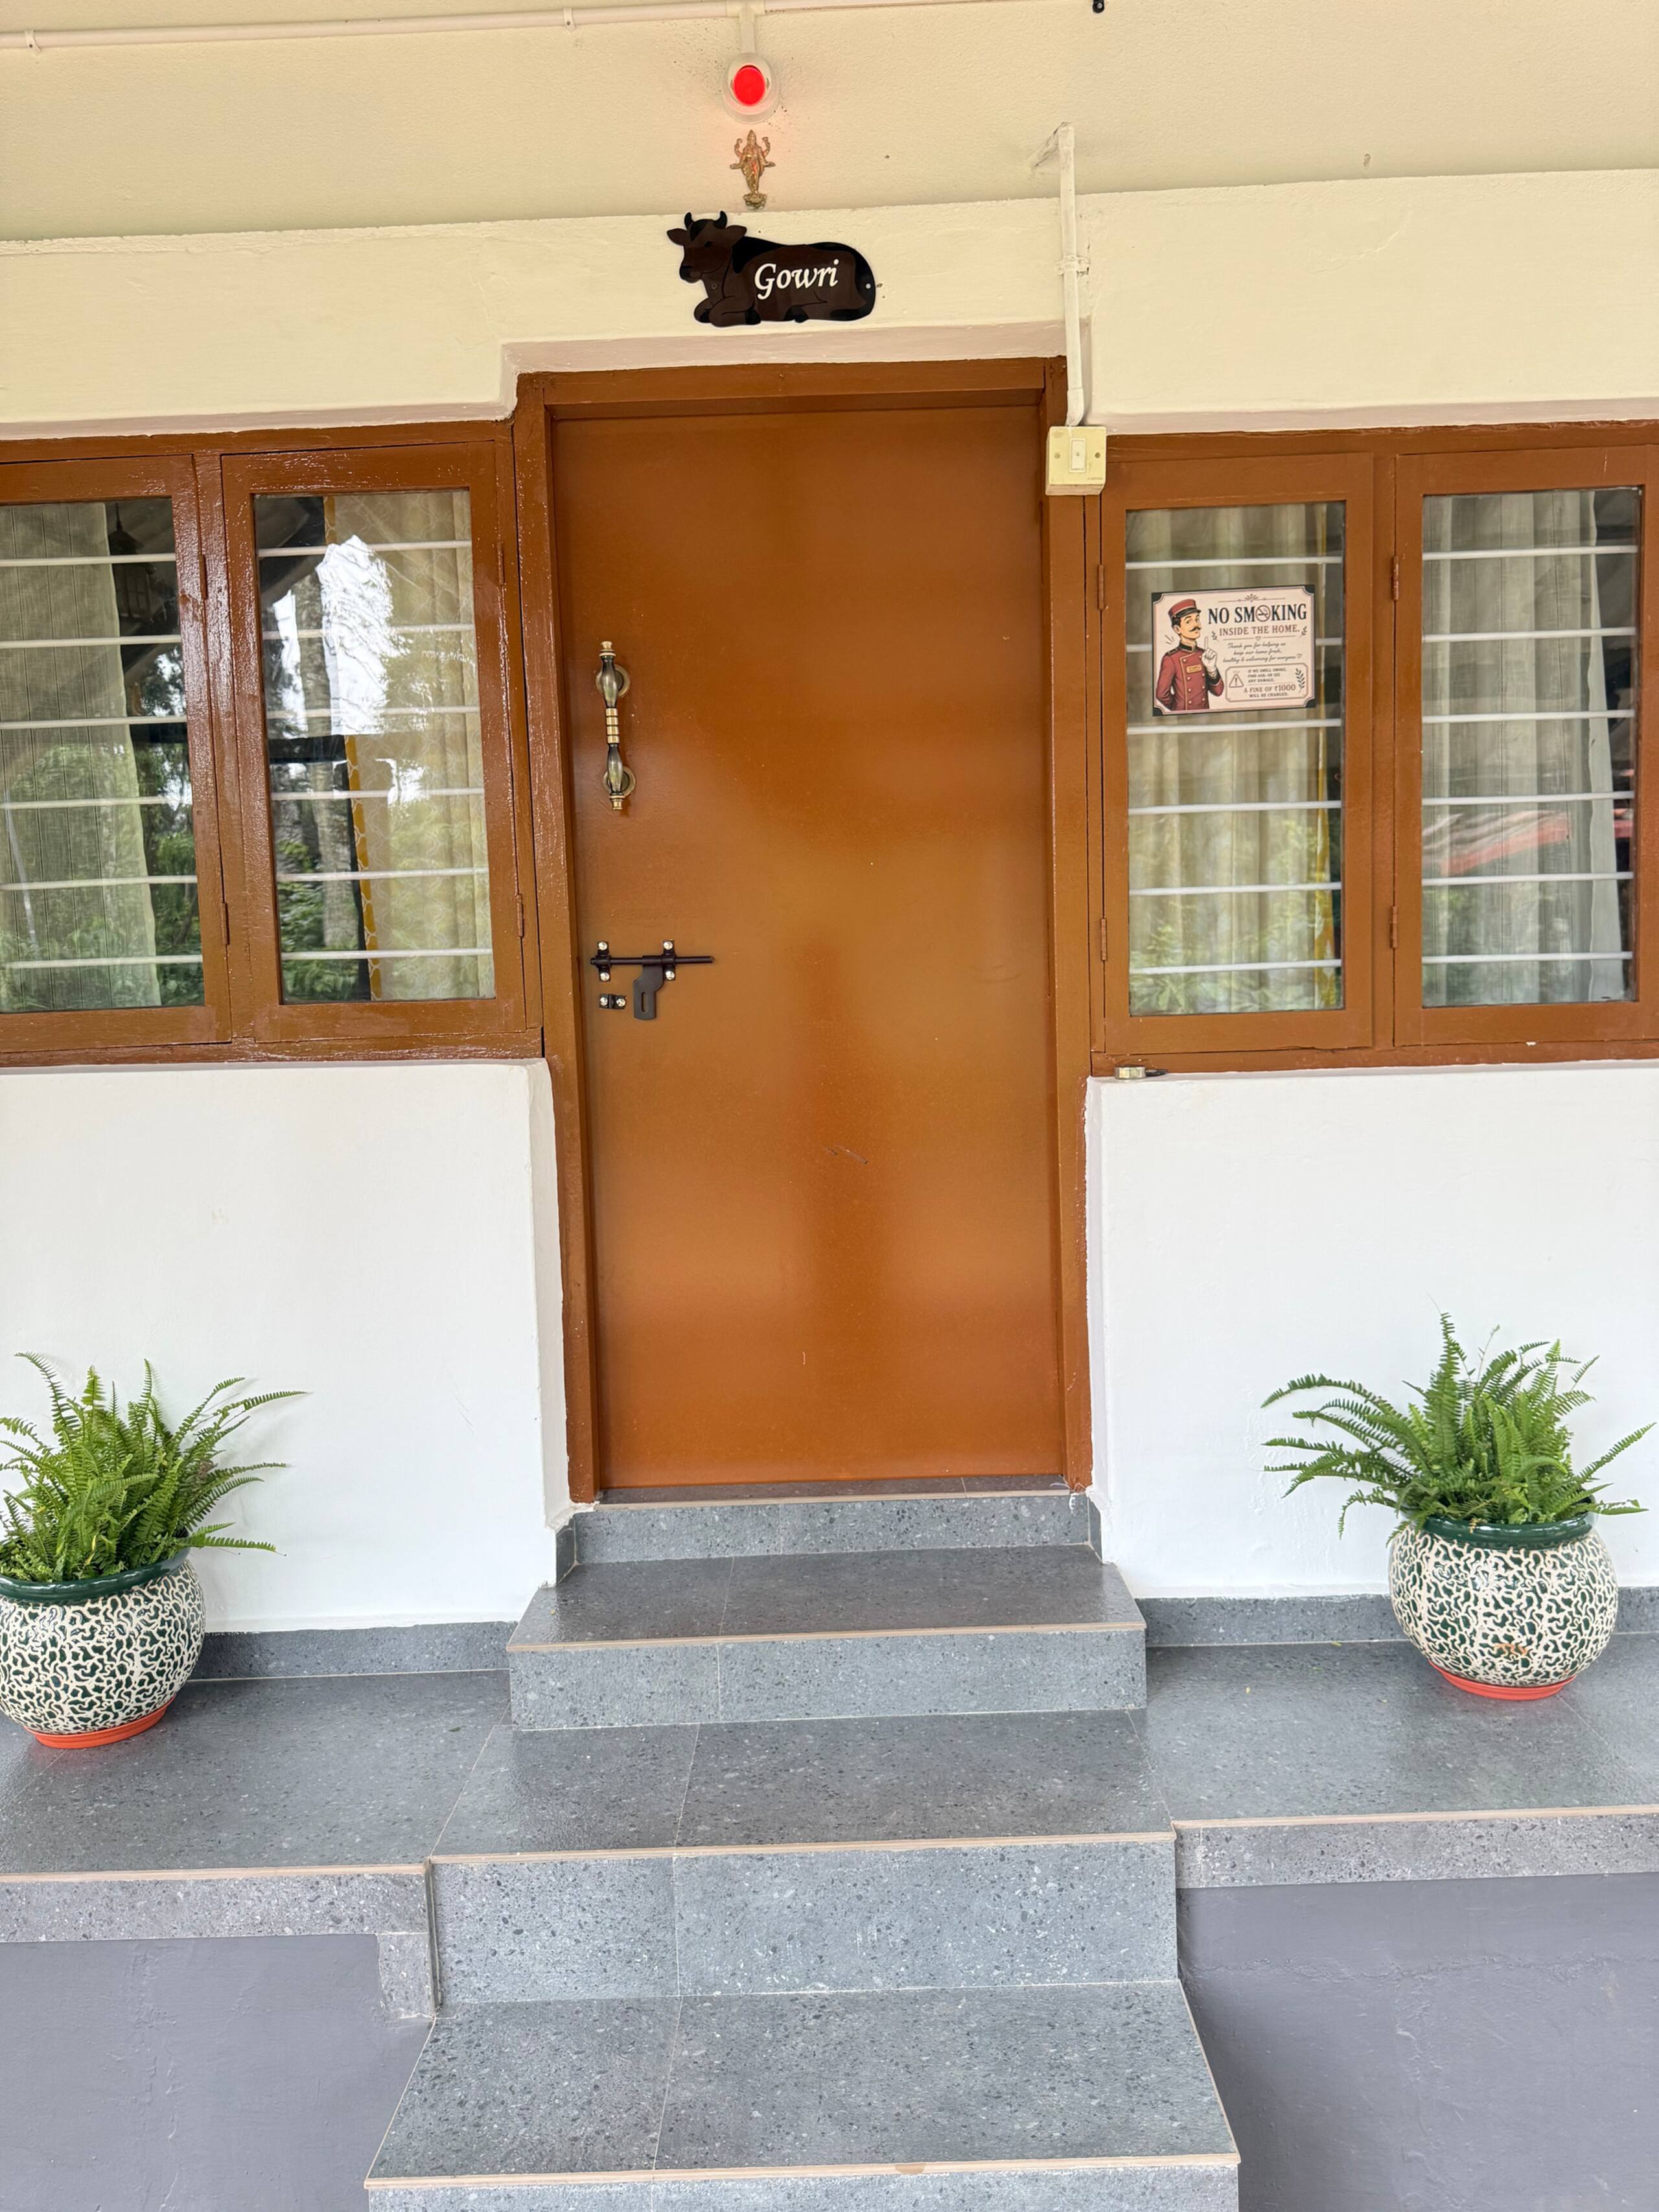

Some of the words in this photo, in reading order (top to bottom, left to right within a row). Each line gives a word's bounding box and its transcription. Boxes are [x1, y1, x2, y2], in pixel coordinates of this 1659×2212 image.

[754, 259, 839, 300] Gowri
[1208, 607, 1229, 624] NO
[1234, 603, 1307, 623] SMOKING
[1220, 627, 1249, 636] INSIDE
[1251, 625, 1270, 634] THE
[1272, 624, 1300, 633] HOME.
